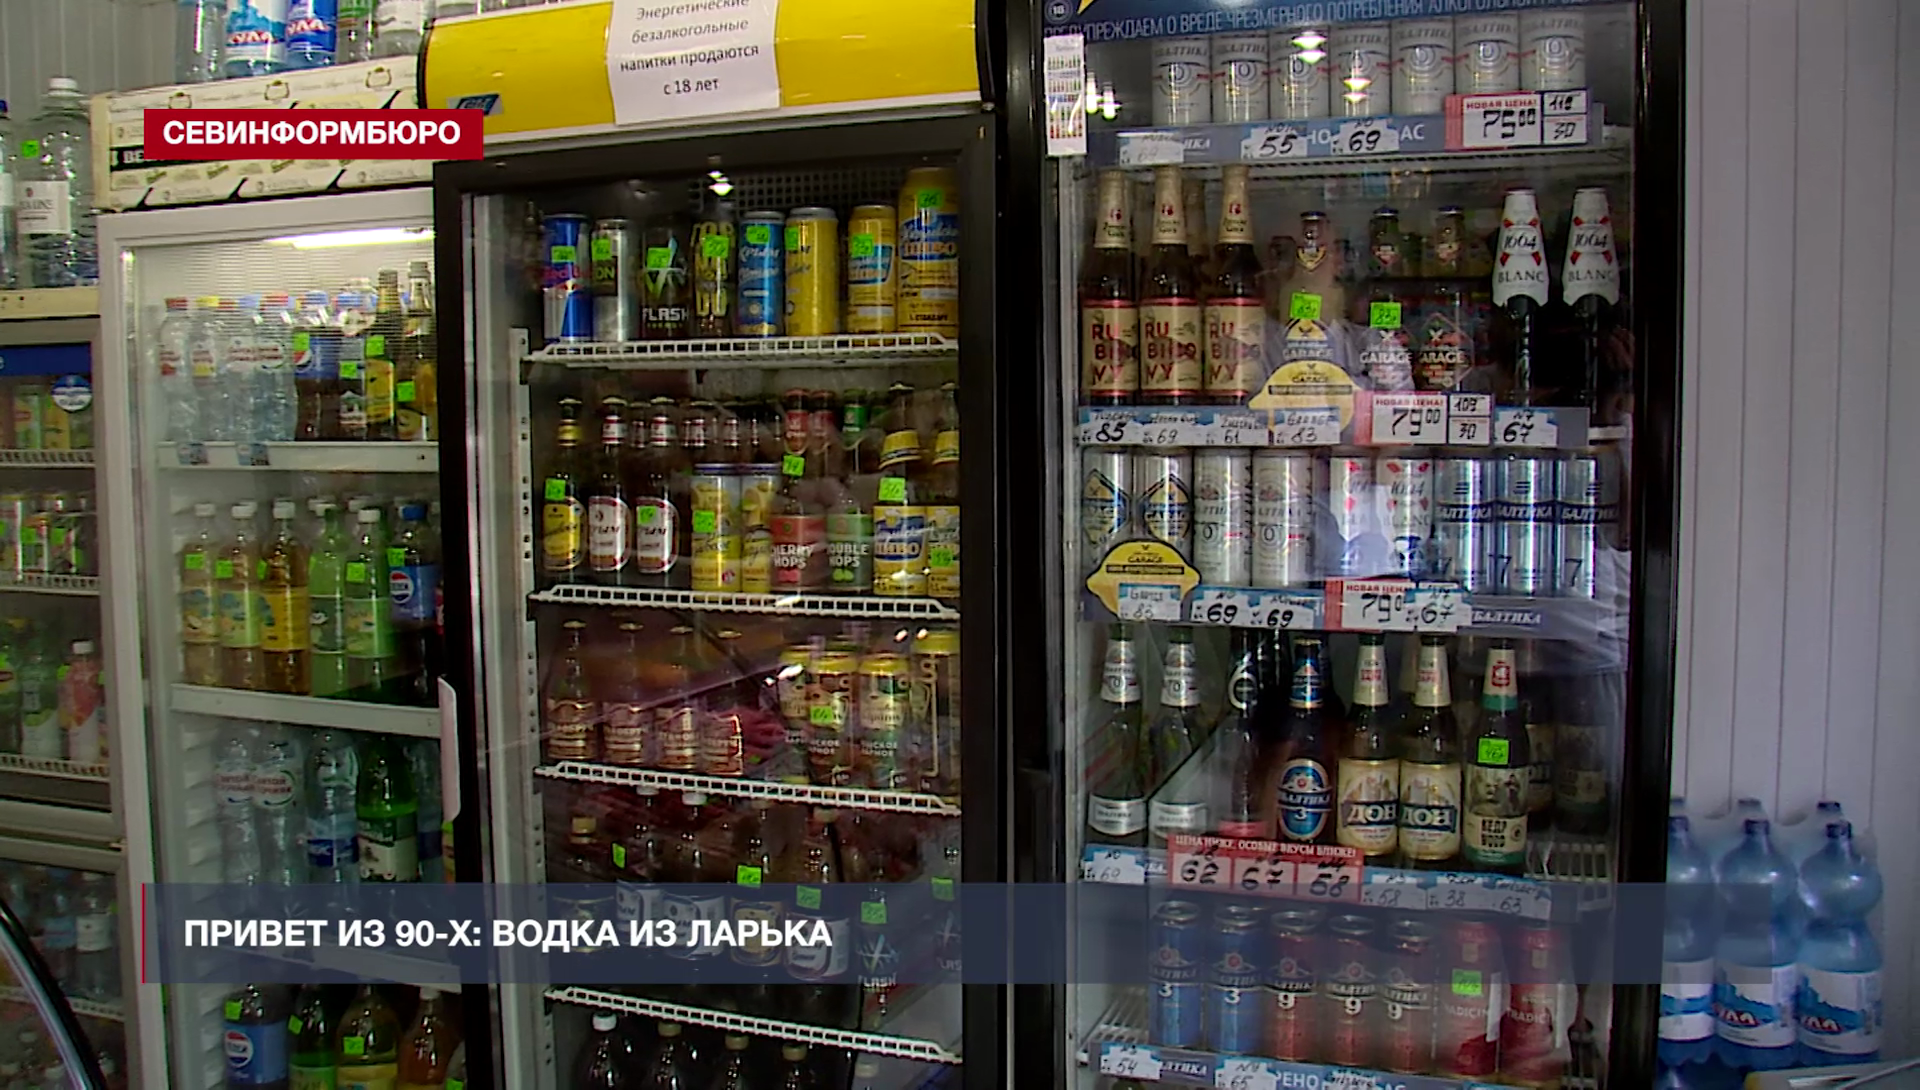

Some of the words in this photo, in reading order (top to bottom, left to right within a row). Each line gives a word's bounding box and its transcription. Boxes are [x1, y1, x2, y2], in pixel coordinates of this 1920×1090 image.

[1167, 17, 1175, 33] О
[1180, 11, 1222, 34] ВРЕДЕ
[1229, 4, 1321, 29] ЧРЕЗМЕРНОГО
[1327, 0, 1423, 22] ПОТРЕБЛЕНИЯ
[632, 20, 748, 44] безалкогольные
[620, 56, 676, 71] напитки
[680, 45, 759, 67] продаются
[664, 83, 670, 95] с
[676, 79, 691, 93] 18
[695, 78, 719, 92] лет
[1259, 135, 1298, 157] 55
[1349, 130, 1381, 152] 69
[1498, 270, 1545, 283] BLANC
[1568, 269, 1616, 283] BLANC
[1145, 322, 1169, 338] RU
[1210, 322, 1235, 338] RU
[1360, 351, 1413, 364] GARAGE
[1096, 421, 1127, 442] 85
[1156, 428, 1178, 444] 69
[1565, 558, 1584, 586] 7
[1207, 603, 1238, 624] 69
[1266, 609, 1294, 628] 69
[1349, 804, 1397, 826] ДОН
[1401, 807, 1450, 828] ДОН
[1176, 836, 1198, 846] ЦЕНА
[1181, 859, 1219, 884] 62
[1309, 873, 1350, 898] 58
[1158, 983, 1173, 997] 3
[1224, 988, 1240, 1004] 3
[1278, 992, 1296, 1008] 9
[1344, 997, 1362, 1015] 9
[1387, 1001, 1403, 1020] 9
[1116, 1060, 1138, 1074] 54
